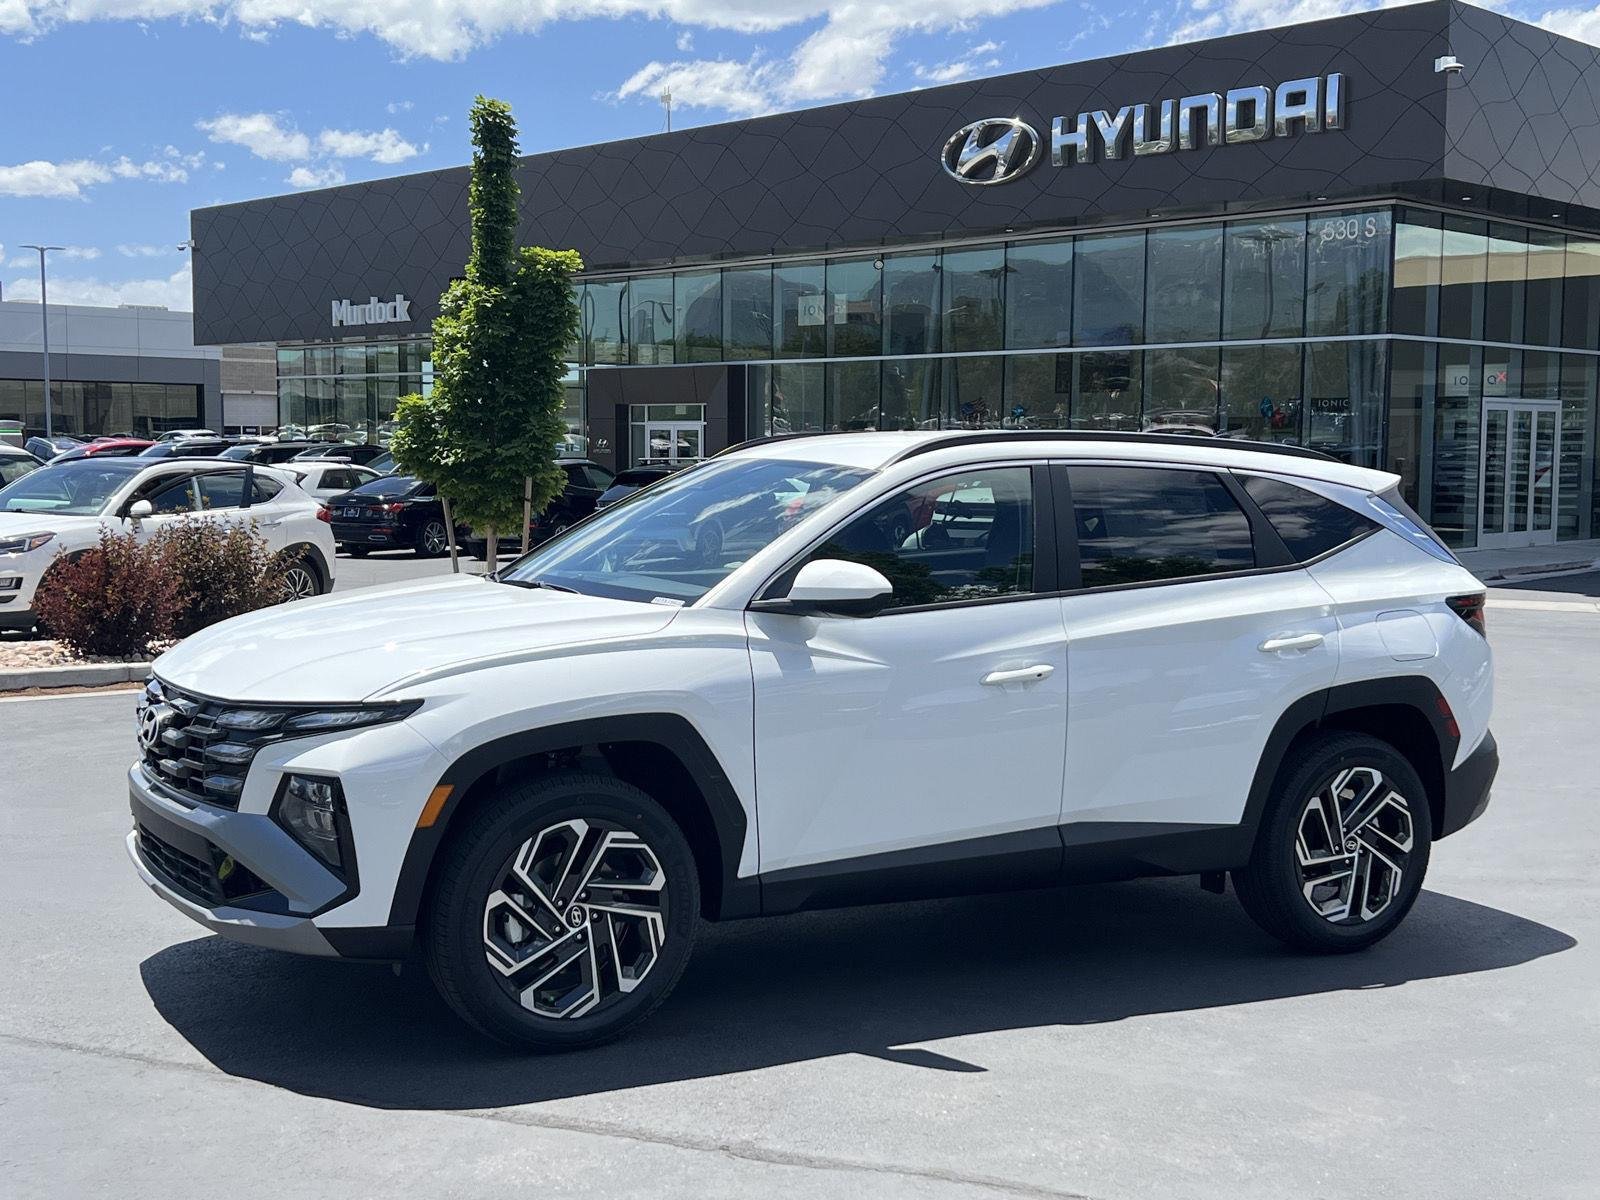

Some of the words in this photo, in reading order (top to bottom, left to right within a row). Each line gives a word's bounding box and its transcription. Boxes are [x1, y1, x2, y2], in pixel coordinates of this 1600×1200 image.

[1051, 73, 1345, 167] HYUNDAI
[1364, 217, 1376, 238] S
[331, 294, 411, 327] Murdock
